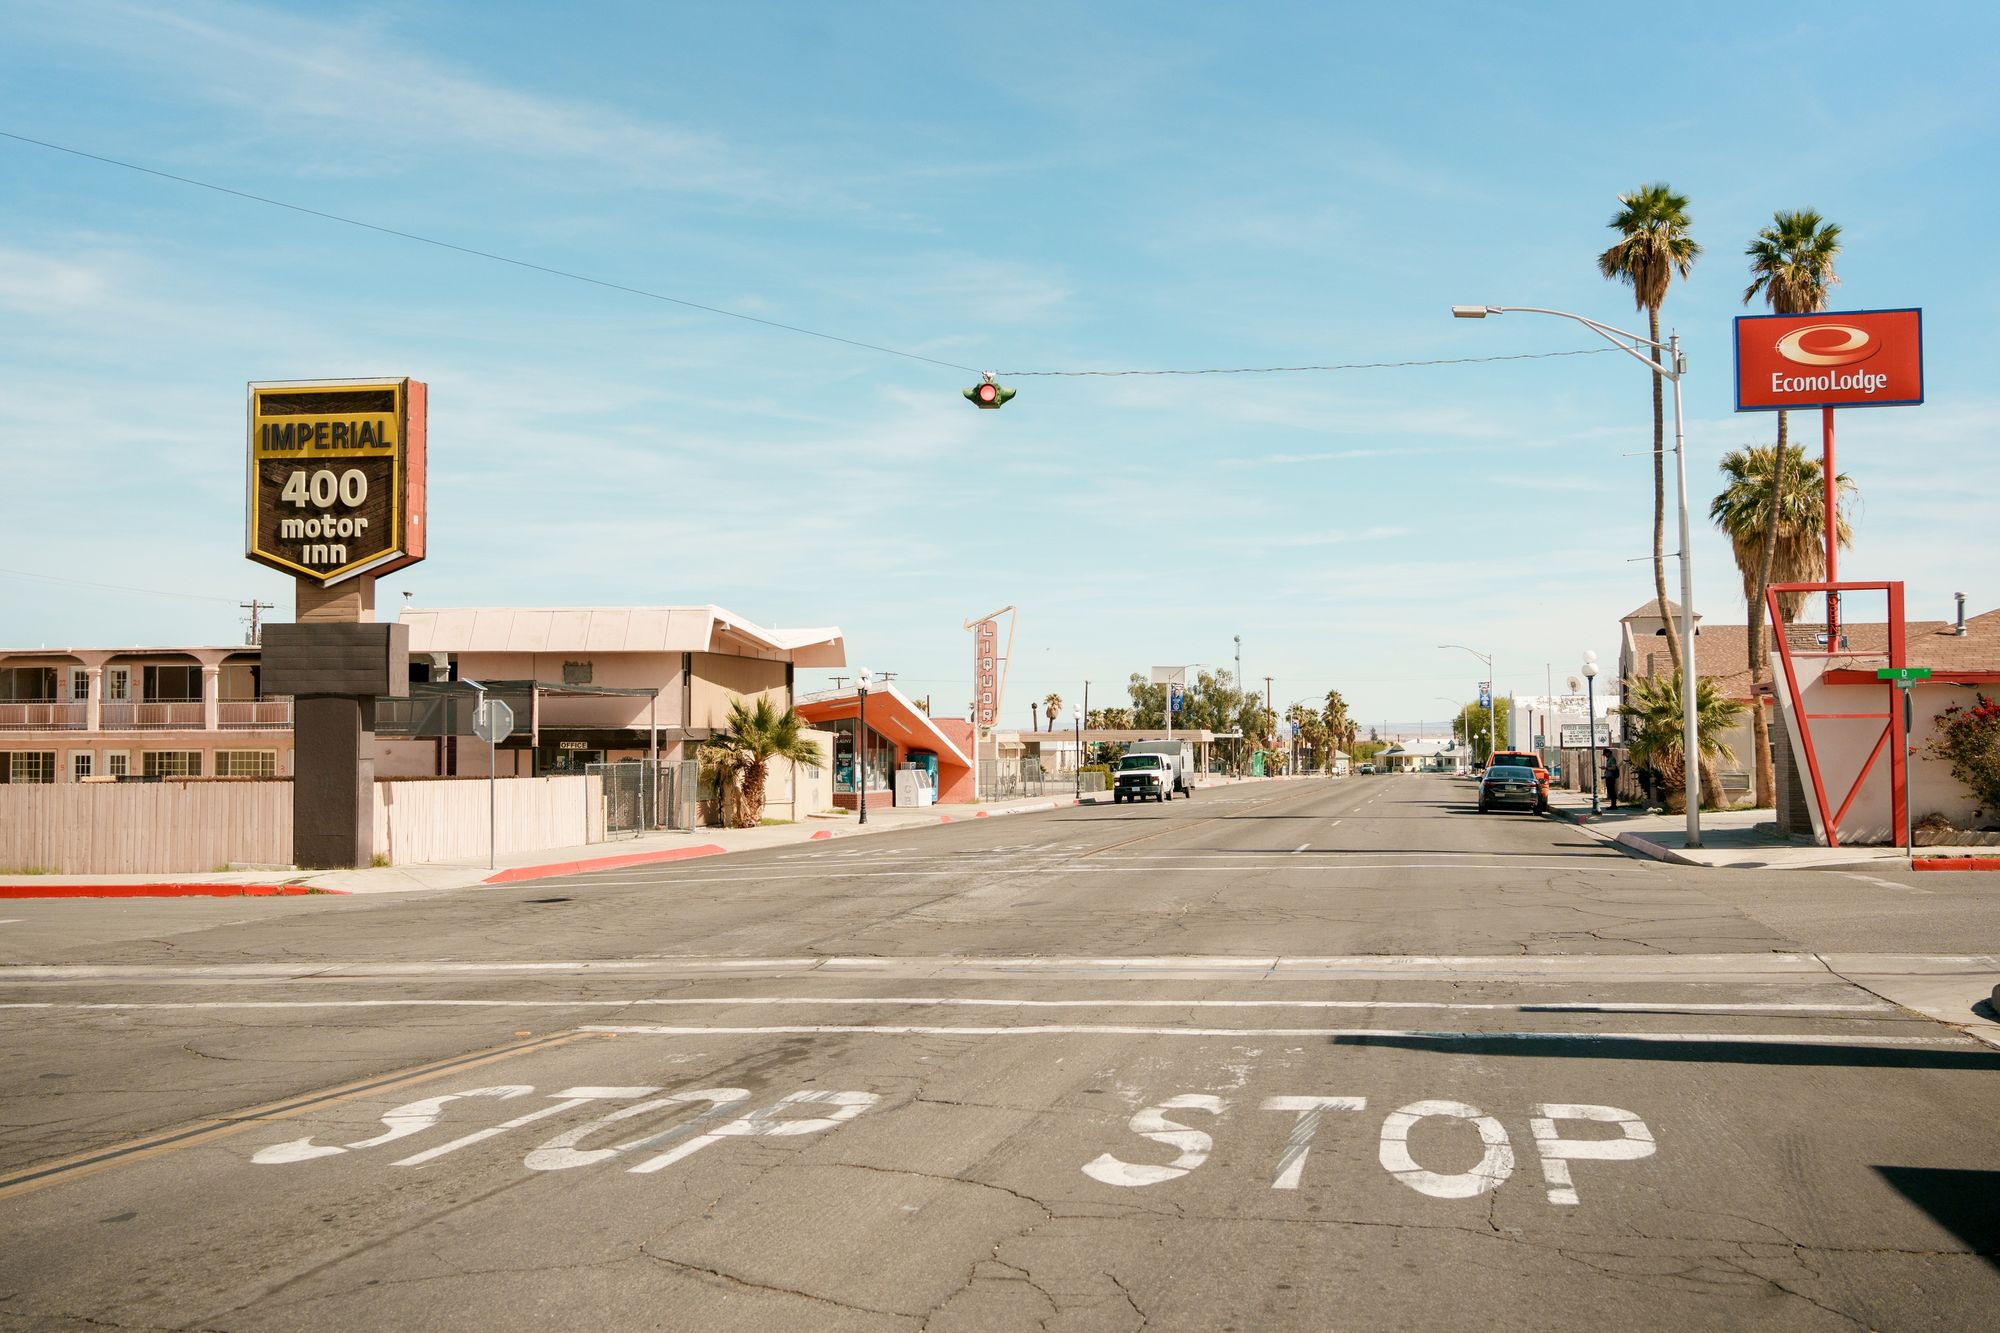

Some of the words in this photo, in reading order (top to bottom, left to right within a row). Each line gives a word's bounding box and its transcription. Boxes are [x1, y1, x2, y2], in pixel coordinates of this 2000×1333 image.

[1771, 369, 1888, 394] EconoLodge
[262, 420, 392, 450] IMPERIAL
[281, 468, 368, 508] 400
[281, 514, 368, 539] motor
[302, 543, 347, 564] inn
[982, 623, 993, 721] LIQUOR
[1901, 669, 1908, 678] D
[250, 1085, 881, 1175] STOP
[1081, 1094, 1657, 1205] STOP
